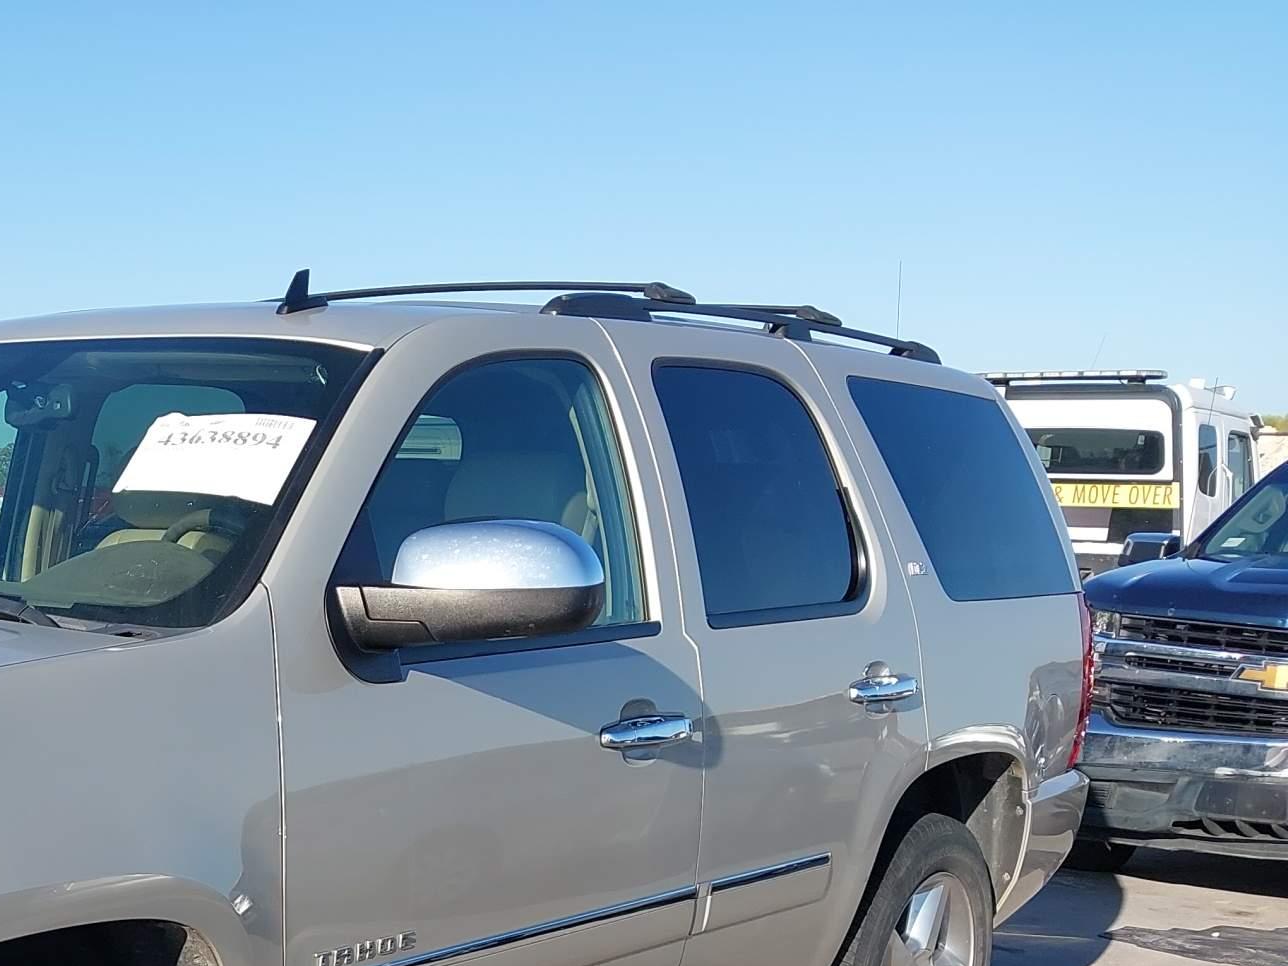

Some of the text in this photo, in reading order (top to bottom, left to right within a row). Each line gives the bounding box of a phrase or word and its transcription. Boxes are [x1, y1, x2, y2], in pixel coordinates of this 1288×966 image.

[158, 430, 283, 448] 43638894
[1055, 485, 1173, 505] & MOVE OVER
